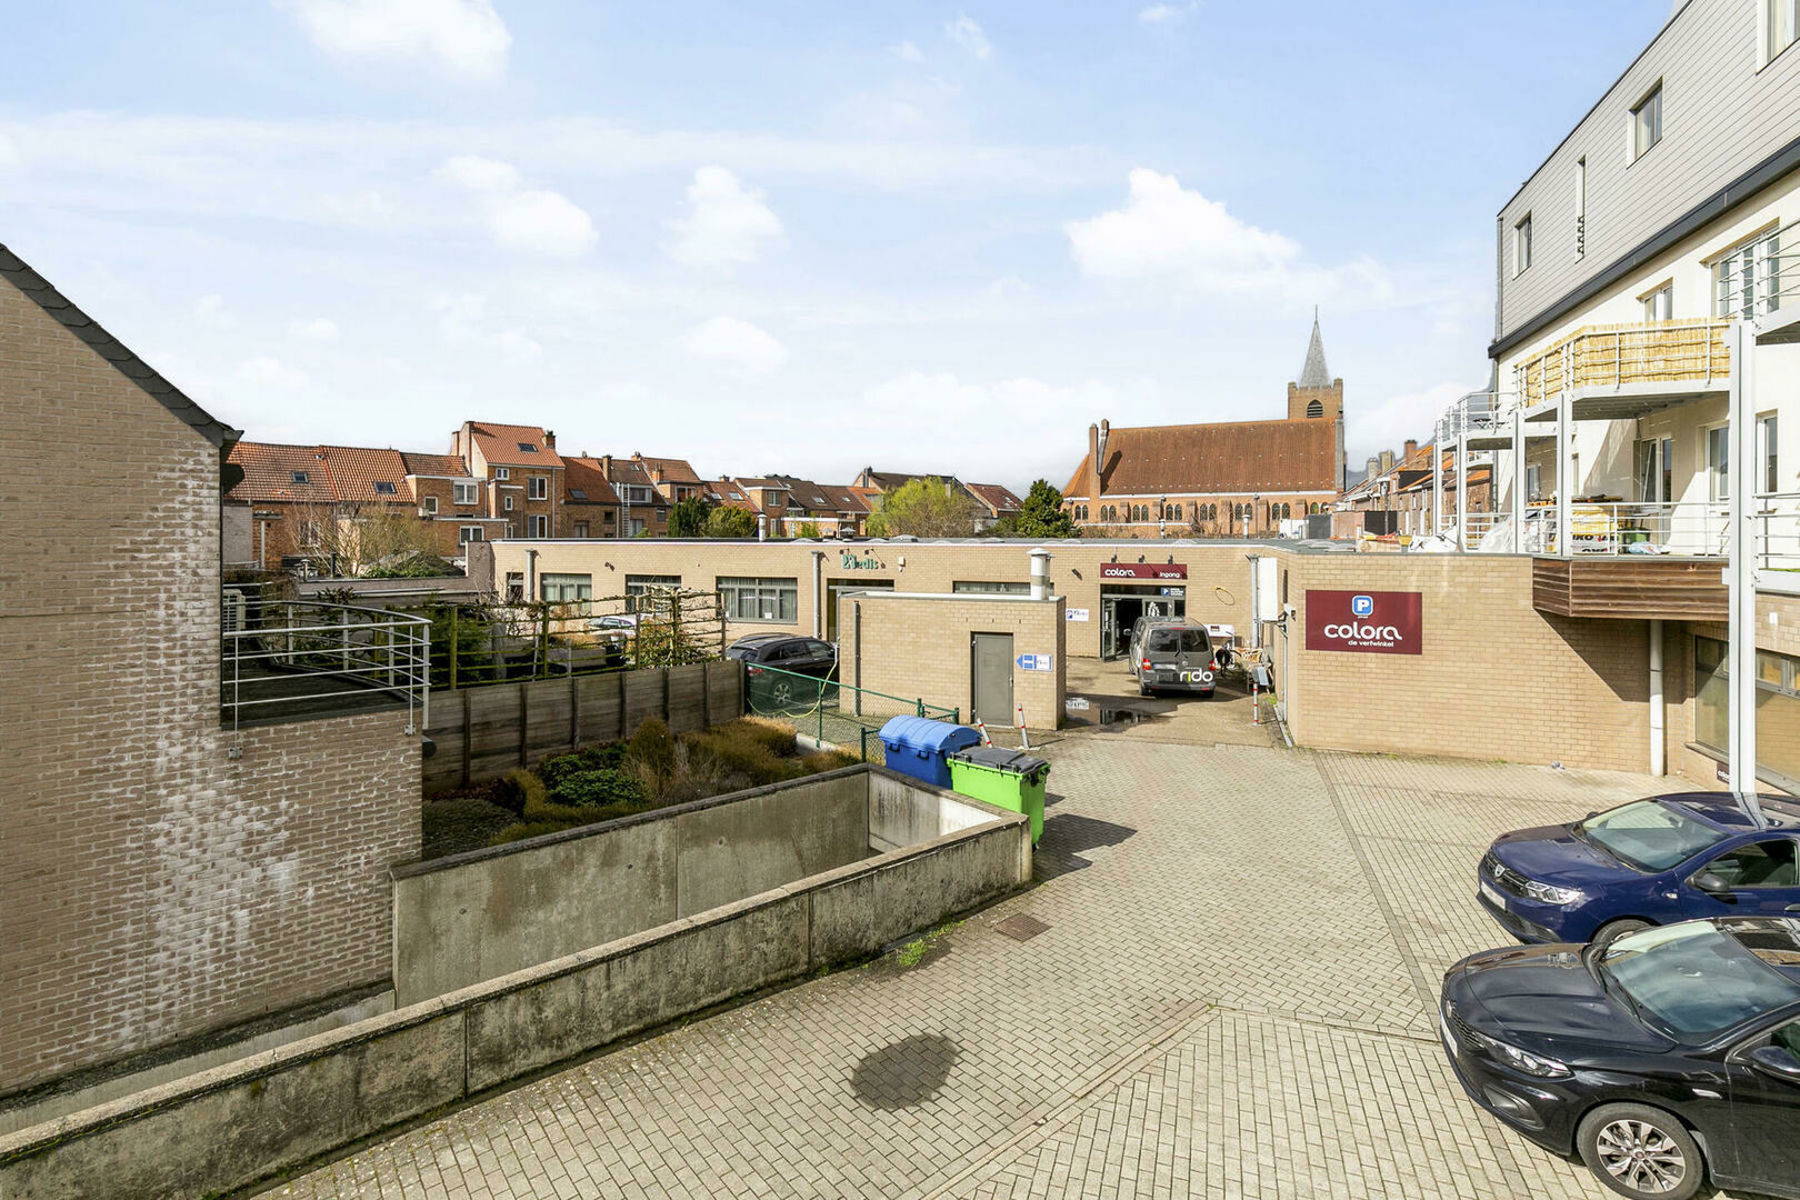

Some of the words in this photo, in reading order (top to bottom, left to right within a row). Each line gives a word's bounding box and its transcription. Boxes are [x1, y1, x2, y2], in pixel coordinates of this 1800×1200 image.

[1104, 567, 1135, 577] colora
[1357, 599, 1370, 611] P
[1324, 621, 1402, 640] colora
[1180, 667, 1213, 682] rido
